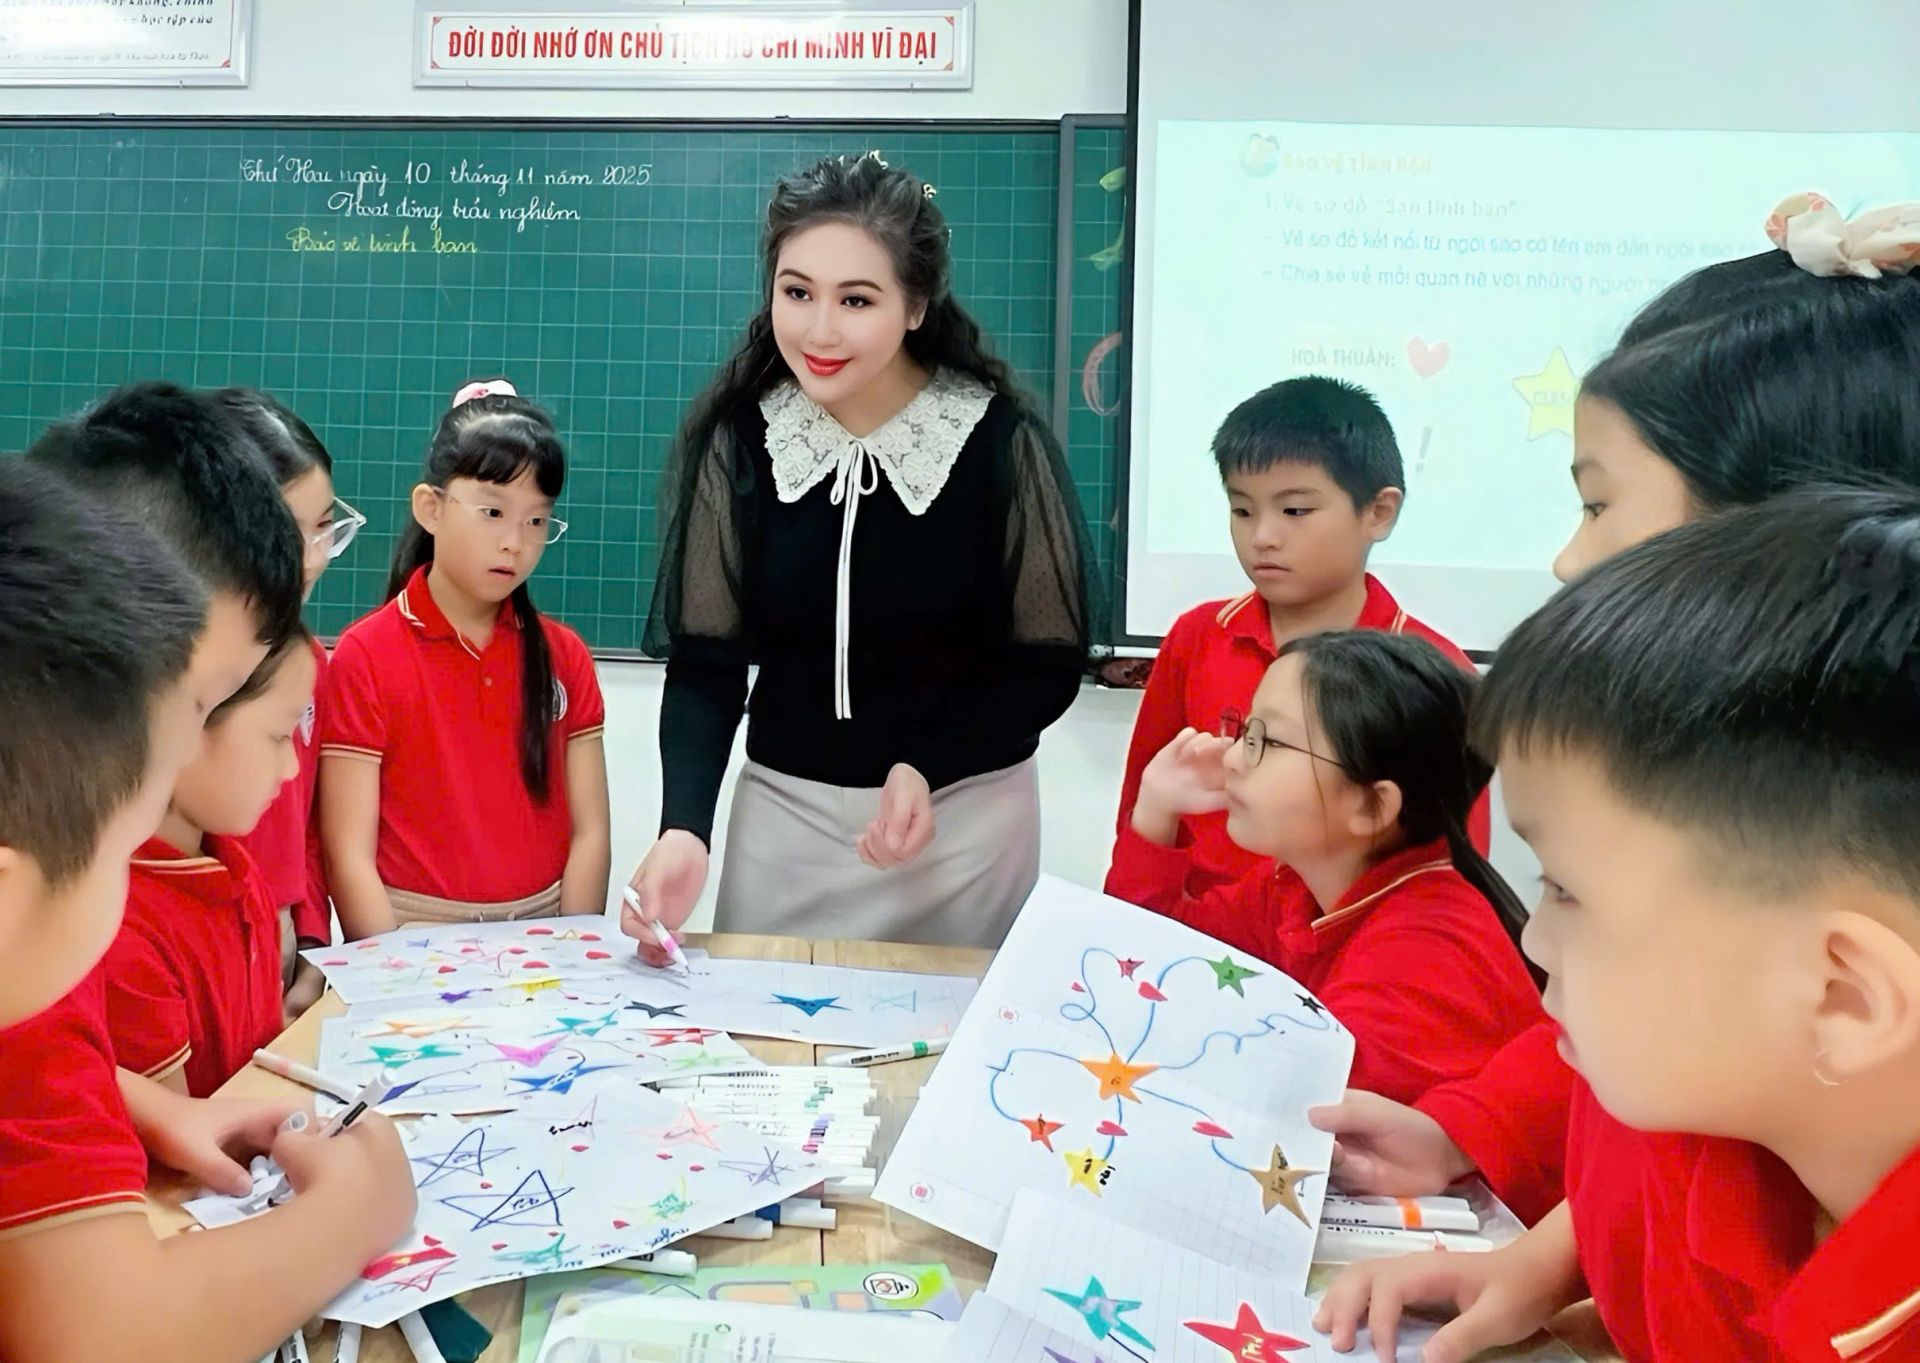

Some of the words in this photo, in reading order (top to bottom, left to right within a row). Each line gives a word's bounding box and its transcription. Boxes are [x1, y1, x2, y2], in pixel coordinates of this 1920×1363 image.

[448, 25, 484, 58] ĐỜI
[491, 25, 526, 58] ĐỜI
[533, 27, 578, 58] NHỚ
[584, 29, 613, 58] ƠN
[620, 23, 664, 58] CHỦ
[872, 27, 893, 59] VĨ
[899, 31, 937, 65] ĐẠI
[239, 155, 285, 183] Thứ
[340, 165, 389, 198] ngày
[404, 161, 431, 185] 10
[450, 159, 511, 197] tháng
[516, 166, 534, 184] 11
[544, 170, 593, 185] năm
[601, 164, 653, 185] 2025
[499, 195, 581, 233] nghiệm
[1415, 270, 1460, 291] quan
